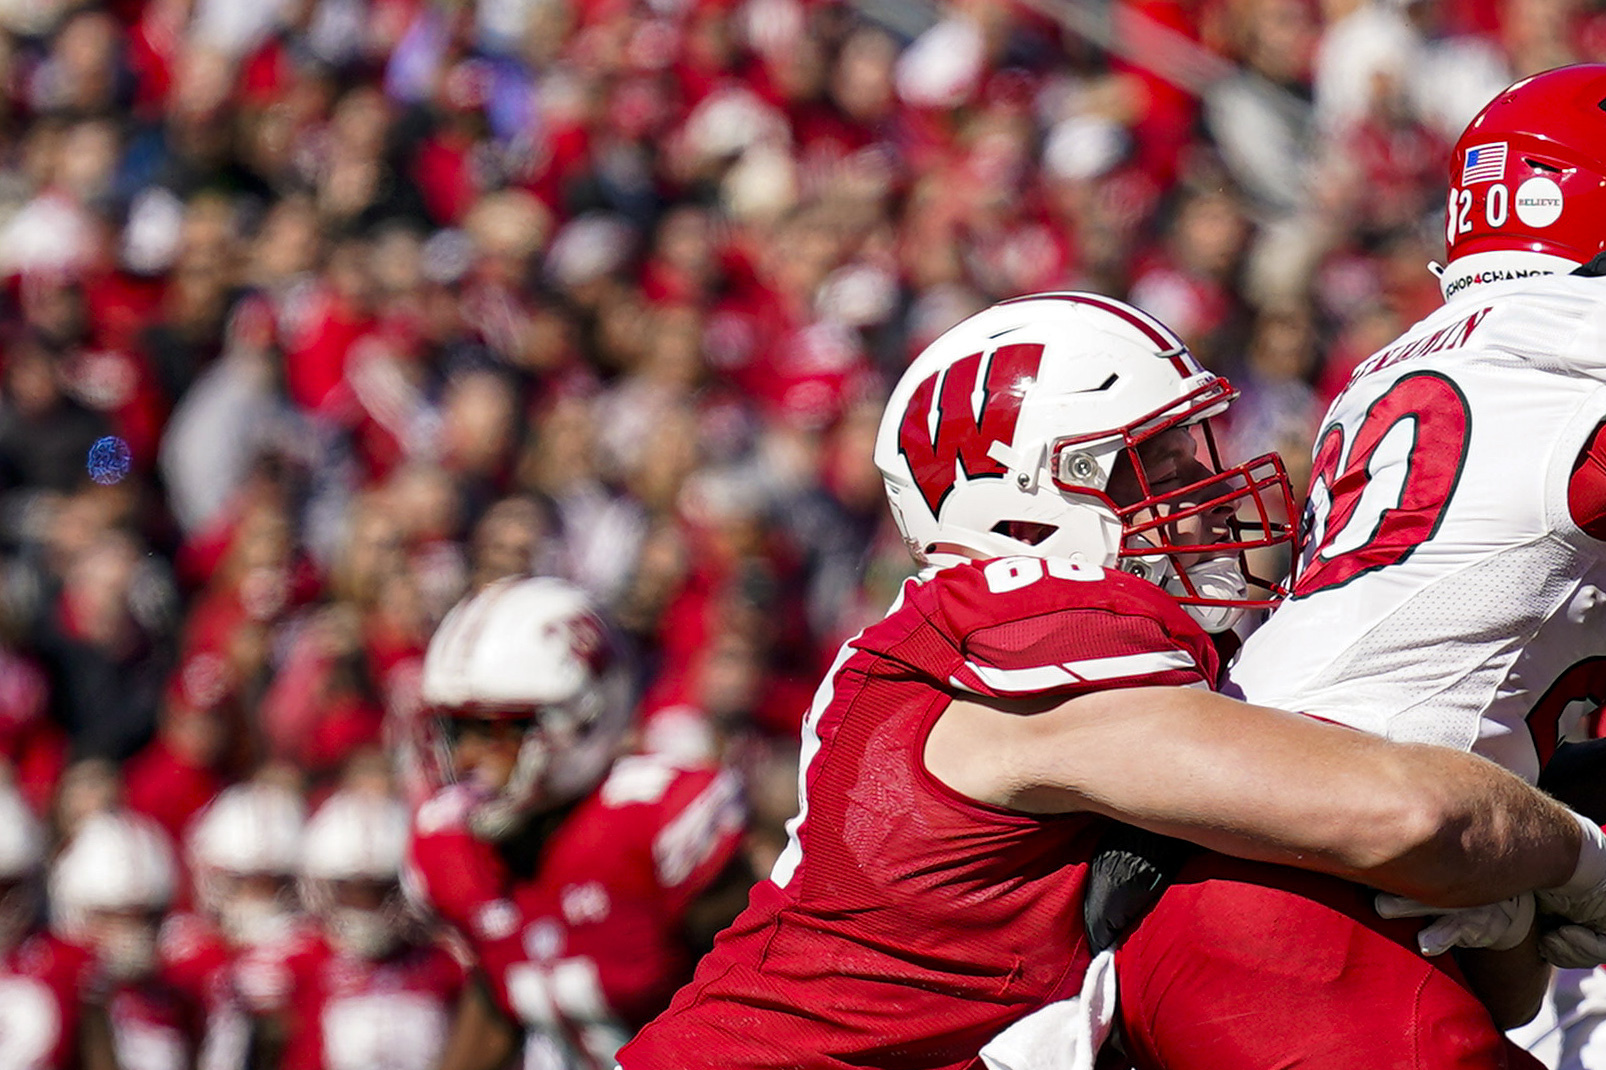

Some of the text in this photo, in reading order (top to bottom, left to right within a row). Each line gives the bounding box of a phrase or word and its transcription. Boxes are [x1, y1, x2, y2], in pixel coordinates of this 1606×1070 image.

[1457, 183, 1510, 235] 20
[1518, 198, 1561, 208] BELIEVE
[897, 342, 1046, 524] W
[1291, 369, 1473, 602] 20
